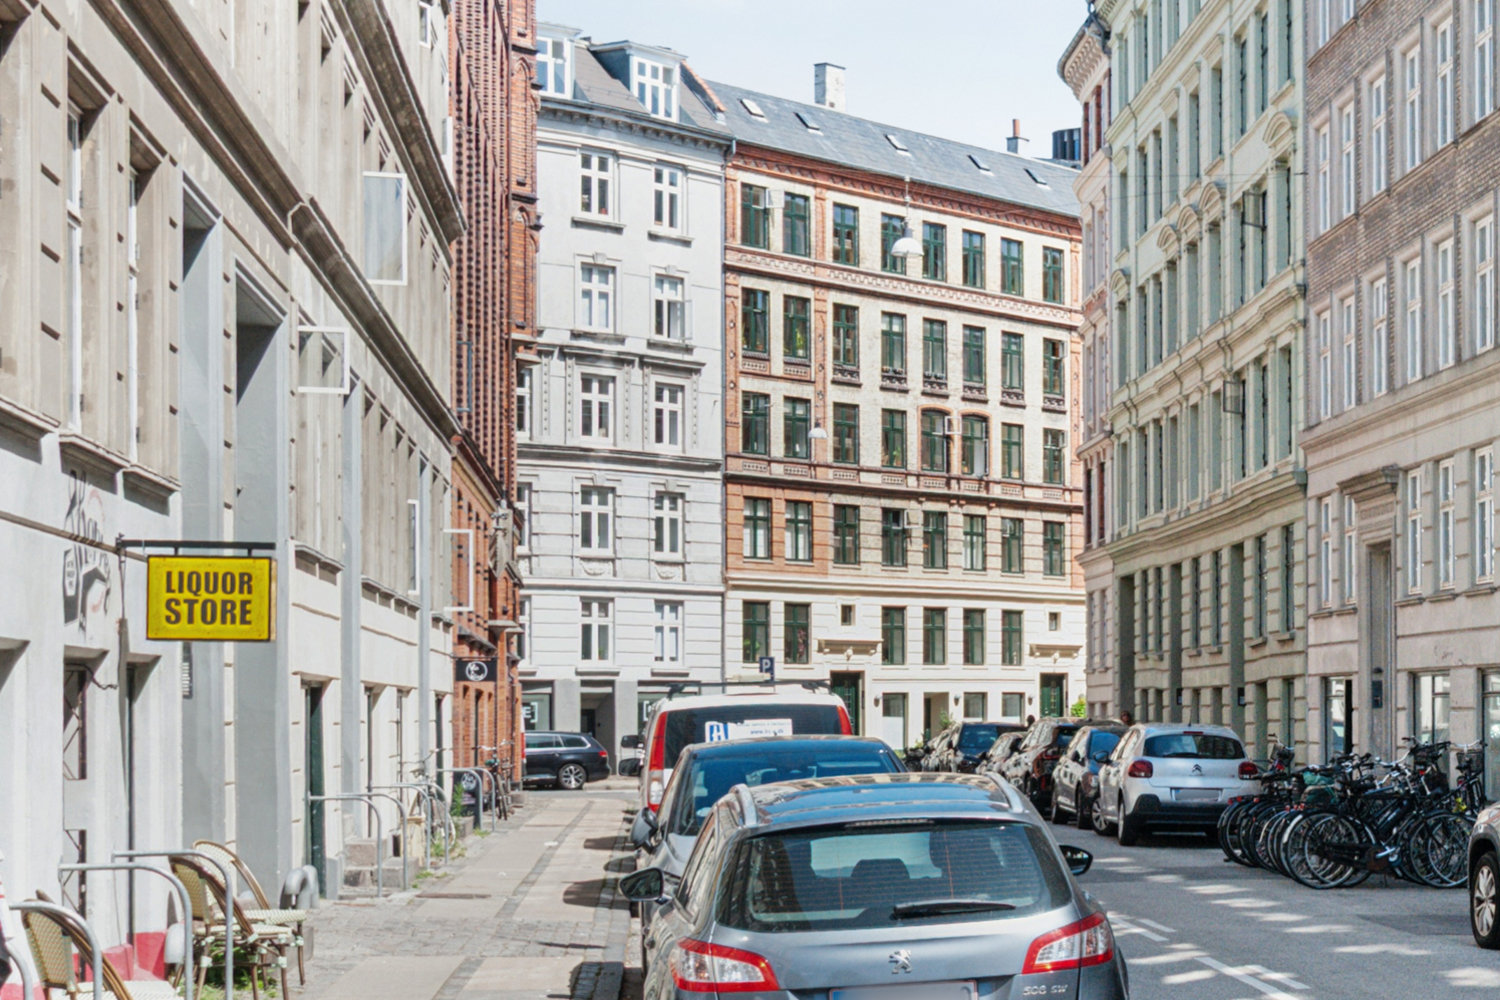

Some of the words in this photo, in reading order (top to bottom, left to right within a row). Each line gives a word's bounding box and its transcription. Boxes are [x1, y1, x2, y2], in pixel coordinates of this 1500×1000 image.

[165, 571, 253, 596] LIQUOR
[165, 598, 252, 625] STORE
[762, 659, 771, 673] P
